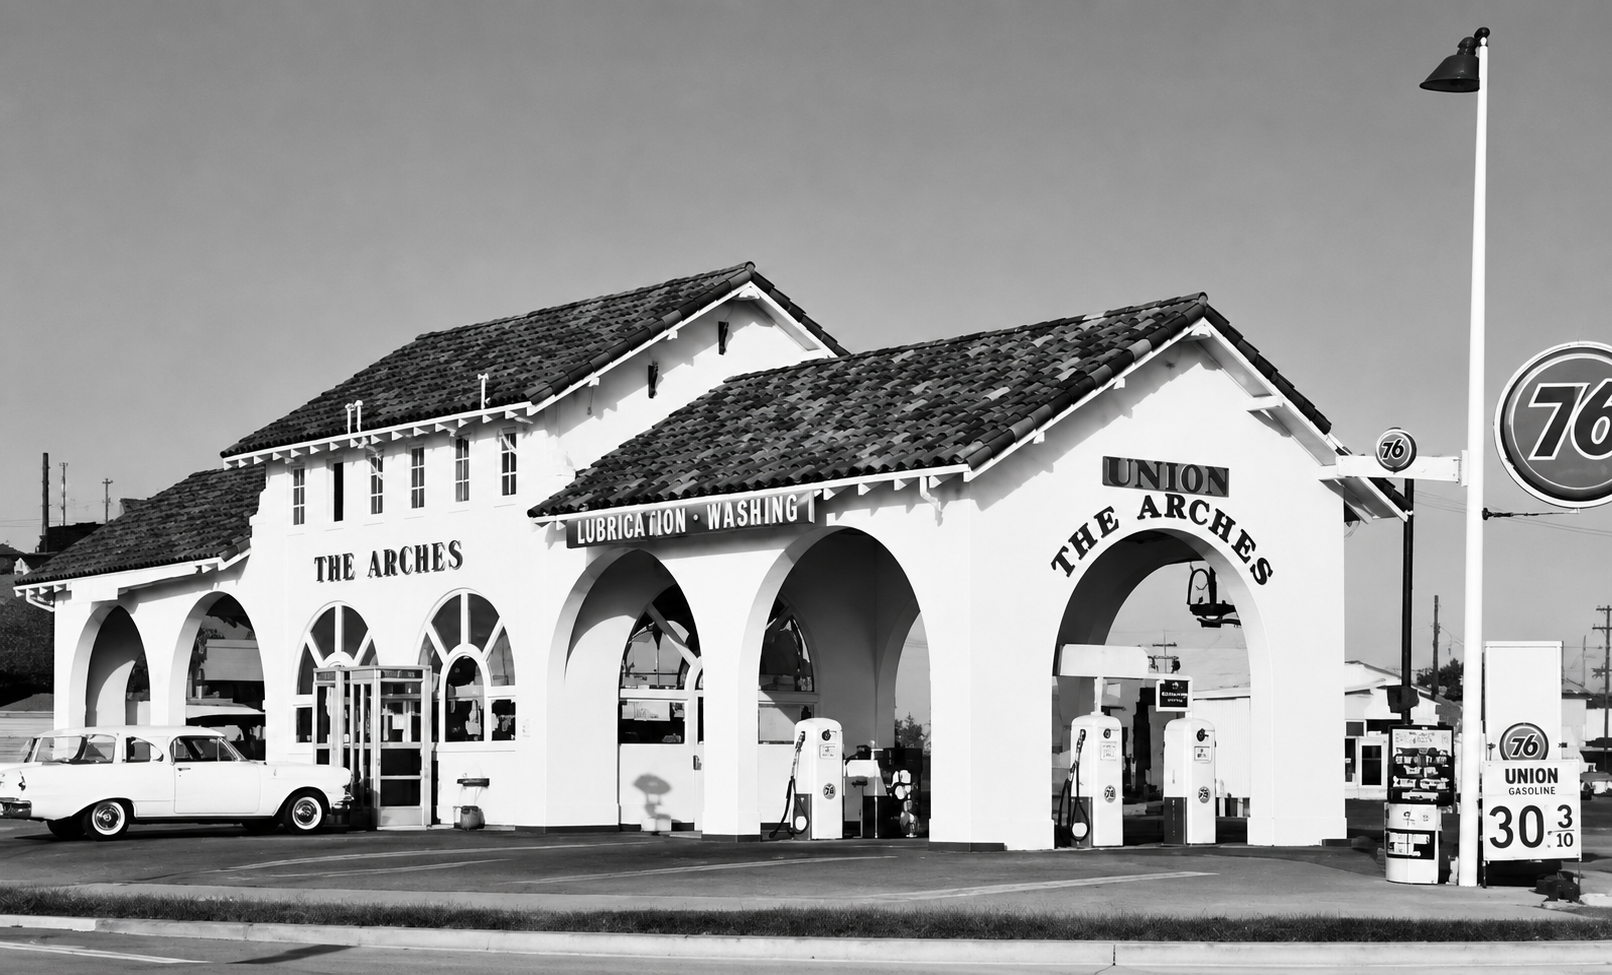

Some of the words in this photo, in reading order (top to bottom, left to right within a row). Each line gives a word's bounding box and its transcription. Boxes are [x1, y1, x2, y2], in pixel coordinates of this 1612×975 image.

[1527, 377, 1612, 461] 76
[1380, 438, 1405, 460] 76
[1105, 456, 1229, 496] UNION
[706, 493, 798, 530] WASHING
[1050, 505, 1120, 578] THE
[1137, 493, 1273, 585] ARCHES
[313, 552, 356, 583] THE
[367, 539, 463, 578] ARCHES
[1510, 732, 1539, 758] 76
[1505, 767, 1558, 785] UNION
[1508, 786, 1556, 796] GASOLINE
[1489, 804, 1545, 849] 30
[1556, 804, 1573, 829] 3
[1556, 832, 1574, 848] 10
